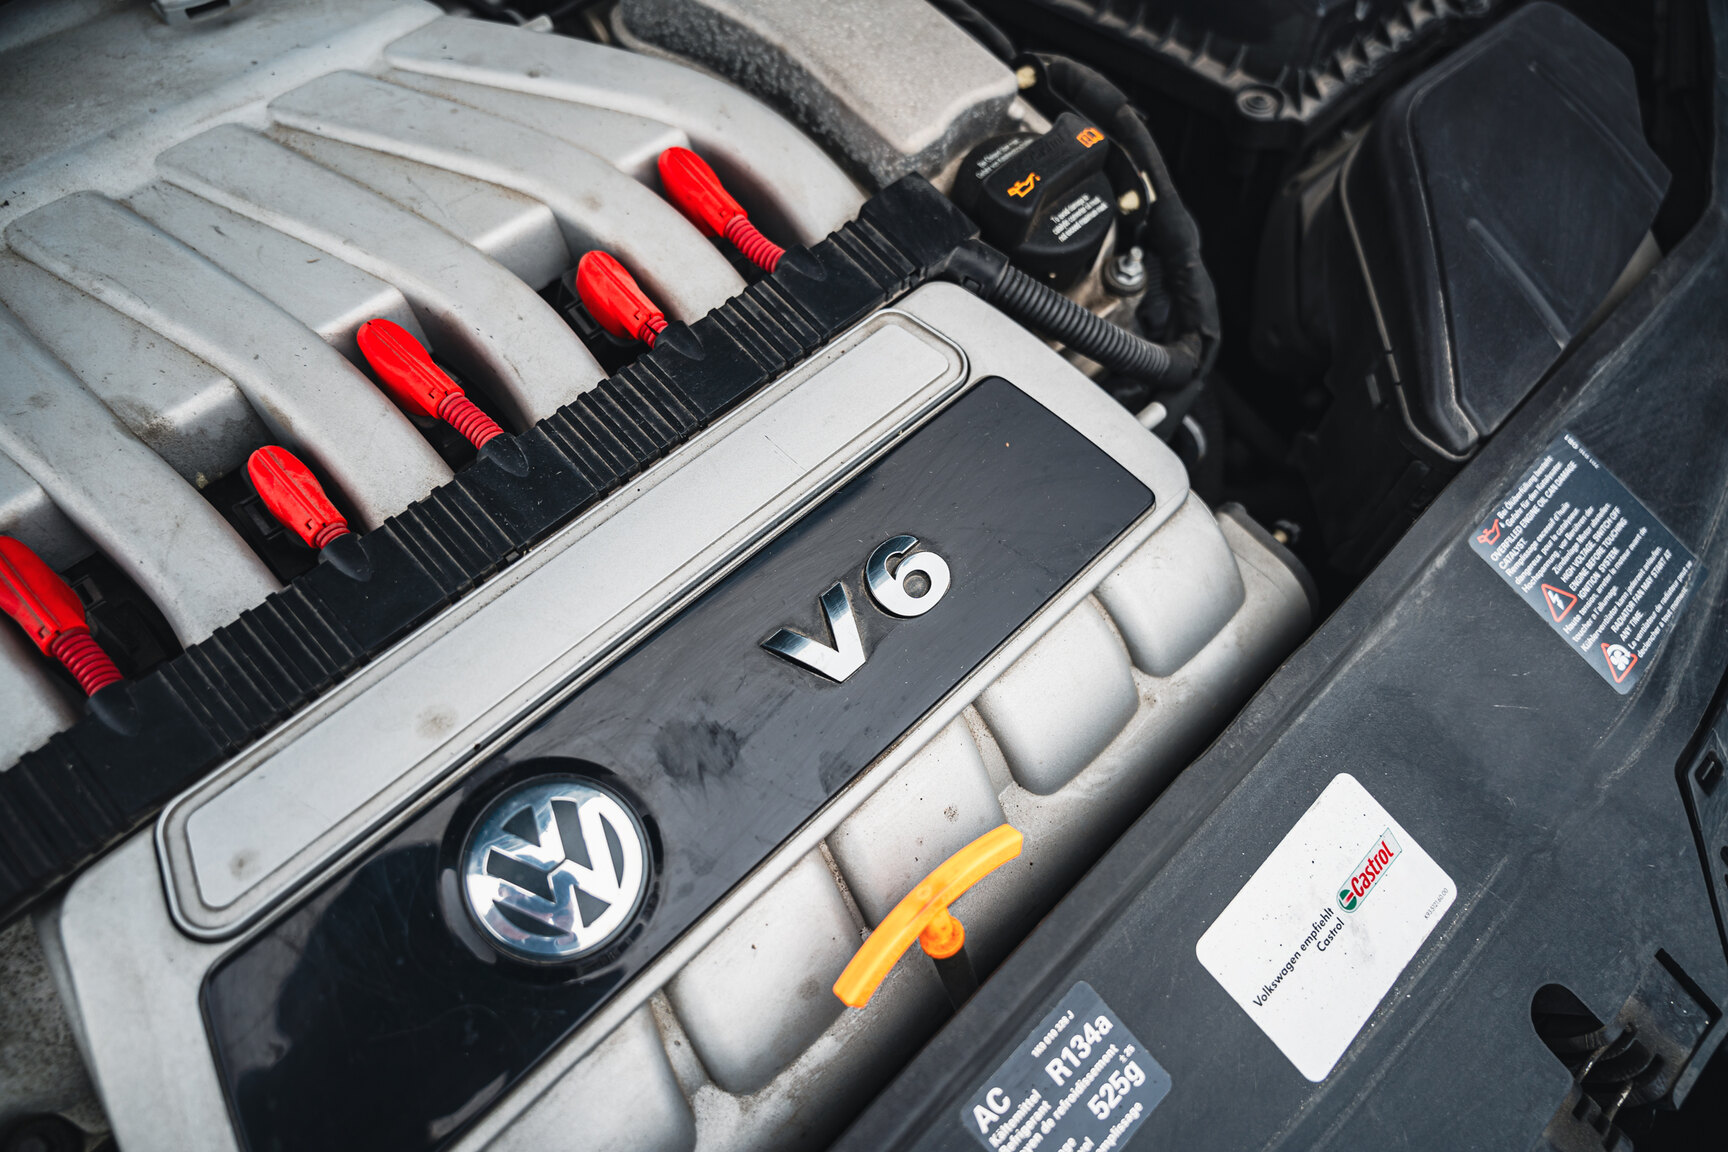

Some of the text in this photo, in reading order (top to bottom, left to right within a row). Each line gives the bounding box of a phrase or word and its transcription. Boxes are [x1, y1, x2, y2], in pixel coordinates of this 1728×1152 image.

[1489, 460, 1577, 563] OVERFILLED ENGINE OIL CAN DAMAGE
[1496, 506, 1508, 520] Bei
[1503, 474, 1538, 510] Ölüberfüllung
[1504, 507, 1523, 527] Gefahr
[1519, 498, 1530, 509] für
[1527, 488, 1539, 502] den
[1558, 538, 1568, 550] vor
[1564, 515, 1587, 541] Berühren
[1584, 505, 1594, 518] der
[1504, 540, 1538, 578] Remplissage
[1536, 517, 1556, 542] excessif
[1513, 554, 1542, 587] dangereux
[1540, 539, 1553, 556] pour
[1549, 533, 1558, 542] le
[1551, 542, 1580, 575] Zündanlage
[1575, 525, 1592, 544] Motor
[1560, 564, 1576, 583] HIGH
[1592, 517, 1613, 542] SWITCH
[1609, 505, 1620, 520] OFF
[1568, 517, 1628, 591] ENGINE BEFORE TOUCHING
[760, 535, 950, 683] V6
[1561, 614, 1582, 635] Haute
[1608, 567, 1617, 576] le
[1613, 548, 1631, 570] moteur
[1577, 571, 1601, 600] IGNITION
[1580, 605, 1618, 653] Kühlerventilator
[1614, 591, 1629, 608] kann
[1624, 568, 1646, 595] jederzeit
[1610, 548, 1672, 633] RADIATOR FAN MAY START AT
[1627, 640, 1637, 650] Le
[1634, 610, 1657, 642] ventilateur
[1654, 603, 1663, 613] de
[1660, 579, 1679, 605] radiateur
[1571, 617, 1593, 644] toucher
[1619, 624, 1632, 642] ANY
[1351, 840, 1394, 897] Castrol
[1253, 907, 1334, 1007] Volkswagen empfiehlt
[1316, 918, 1345, 952] Castrol
[1045, 1014, 1114, 1087] R134a
[973, 1087, 1011, 1134] AC
[988, 1088, 1041, 1148] Kältemittel
[1040, 1117, 1056, 1134] de
[1049, 1044, 1119, 1120] refroidissement
[1087, 1057, 1145, 1120] 525g
